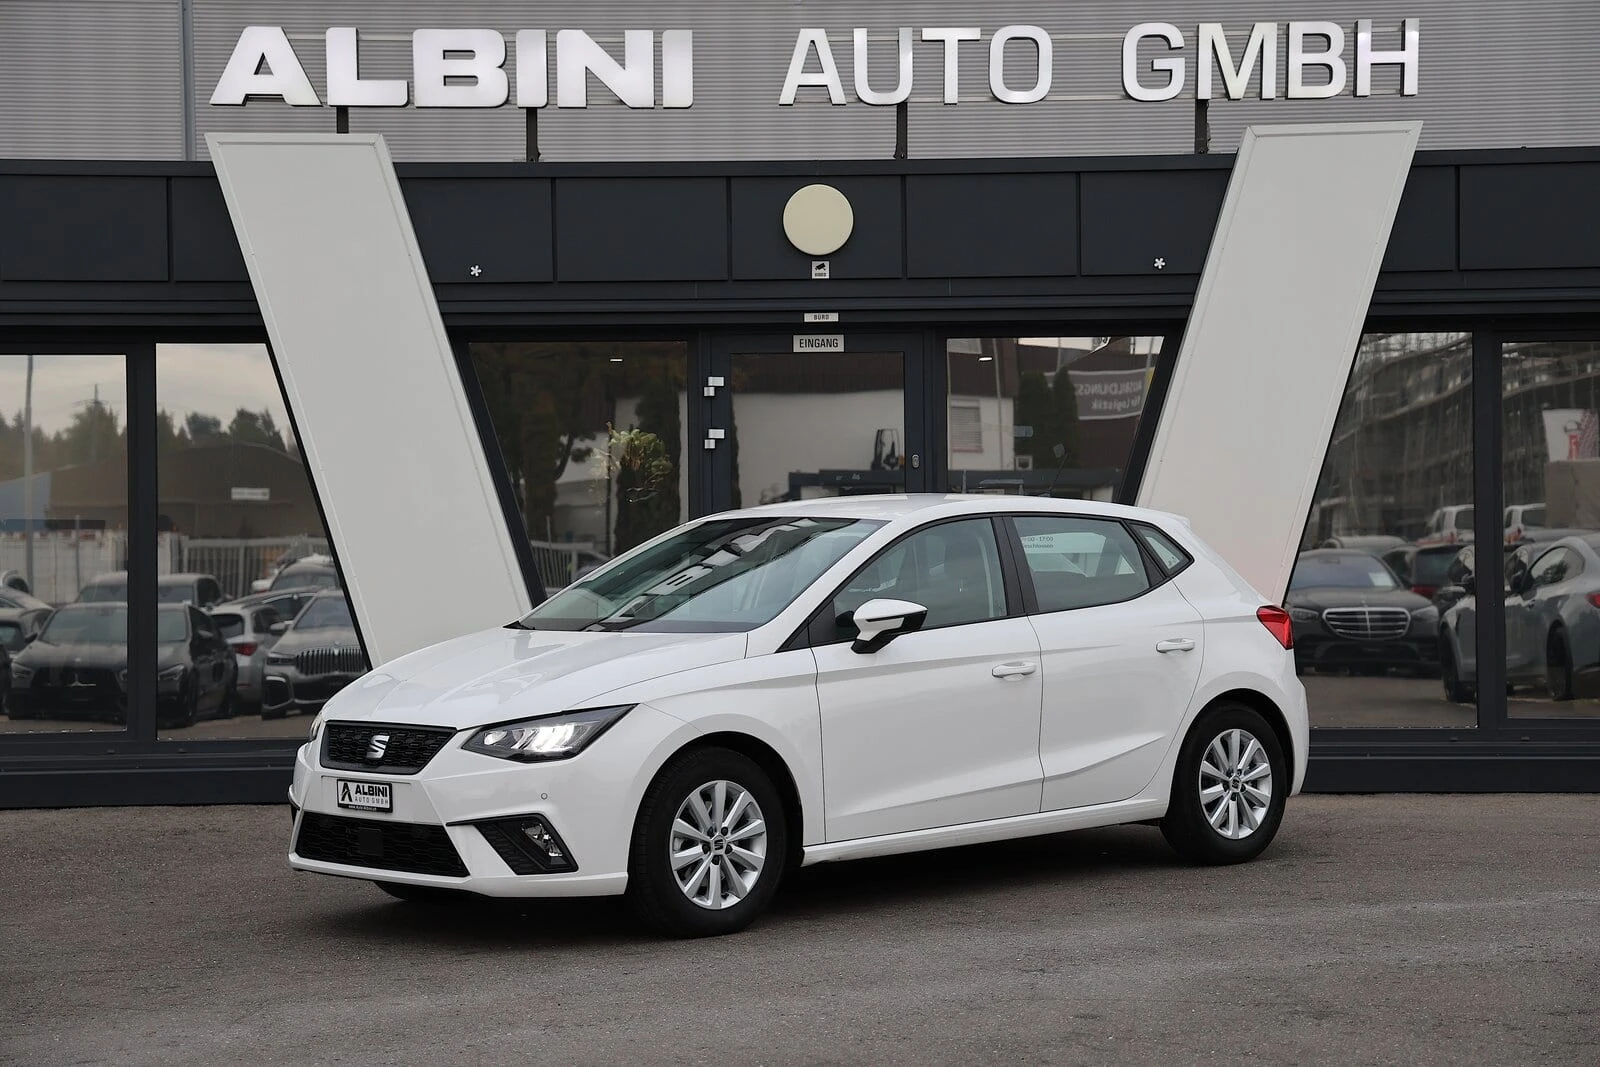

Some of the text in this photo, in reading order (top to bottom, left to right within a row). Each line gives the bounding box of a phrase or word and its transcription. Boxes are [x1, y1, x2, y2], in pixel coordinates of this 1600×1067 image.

[209, 18, 1420, 109] ALBINI AUTO GMBH
[799, 338, 839, 348] EINGANG
[355, 784, 388, 798] ALBINI
